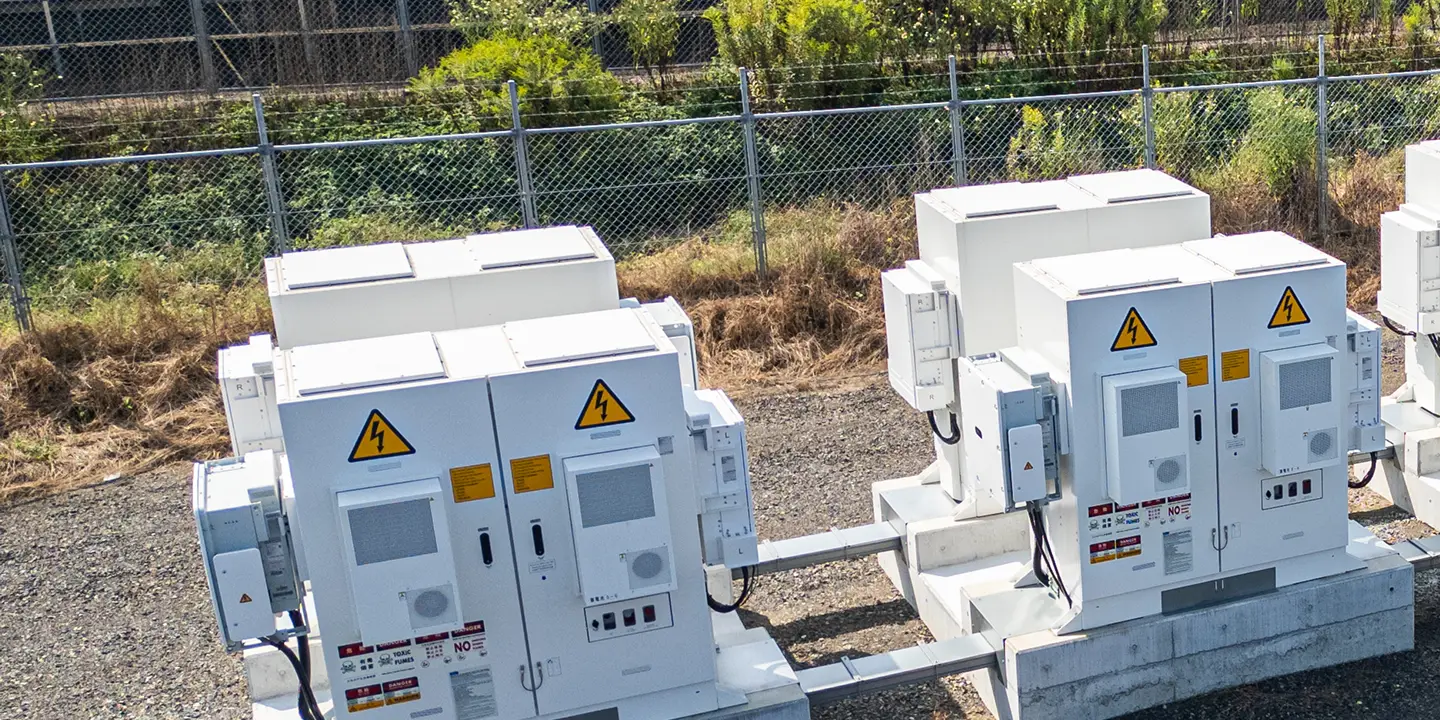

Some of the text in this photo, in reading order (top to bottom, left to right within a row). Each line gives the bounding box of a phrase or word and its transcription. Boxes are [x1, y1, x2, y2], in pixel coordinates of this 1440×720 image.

[1168, 505, 1180, 516] NO
[453, 640, 471, 653] NO
[393, 650, 411, 658] TOXIC
[394, 656, 414, 665] FUMES
